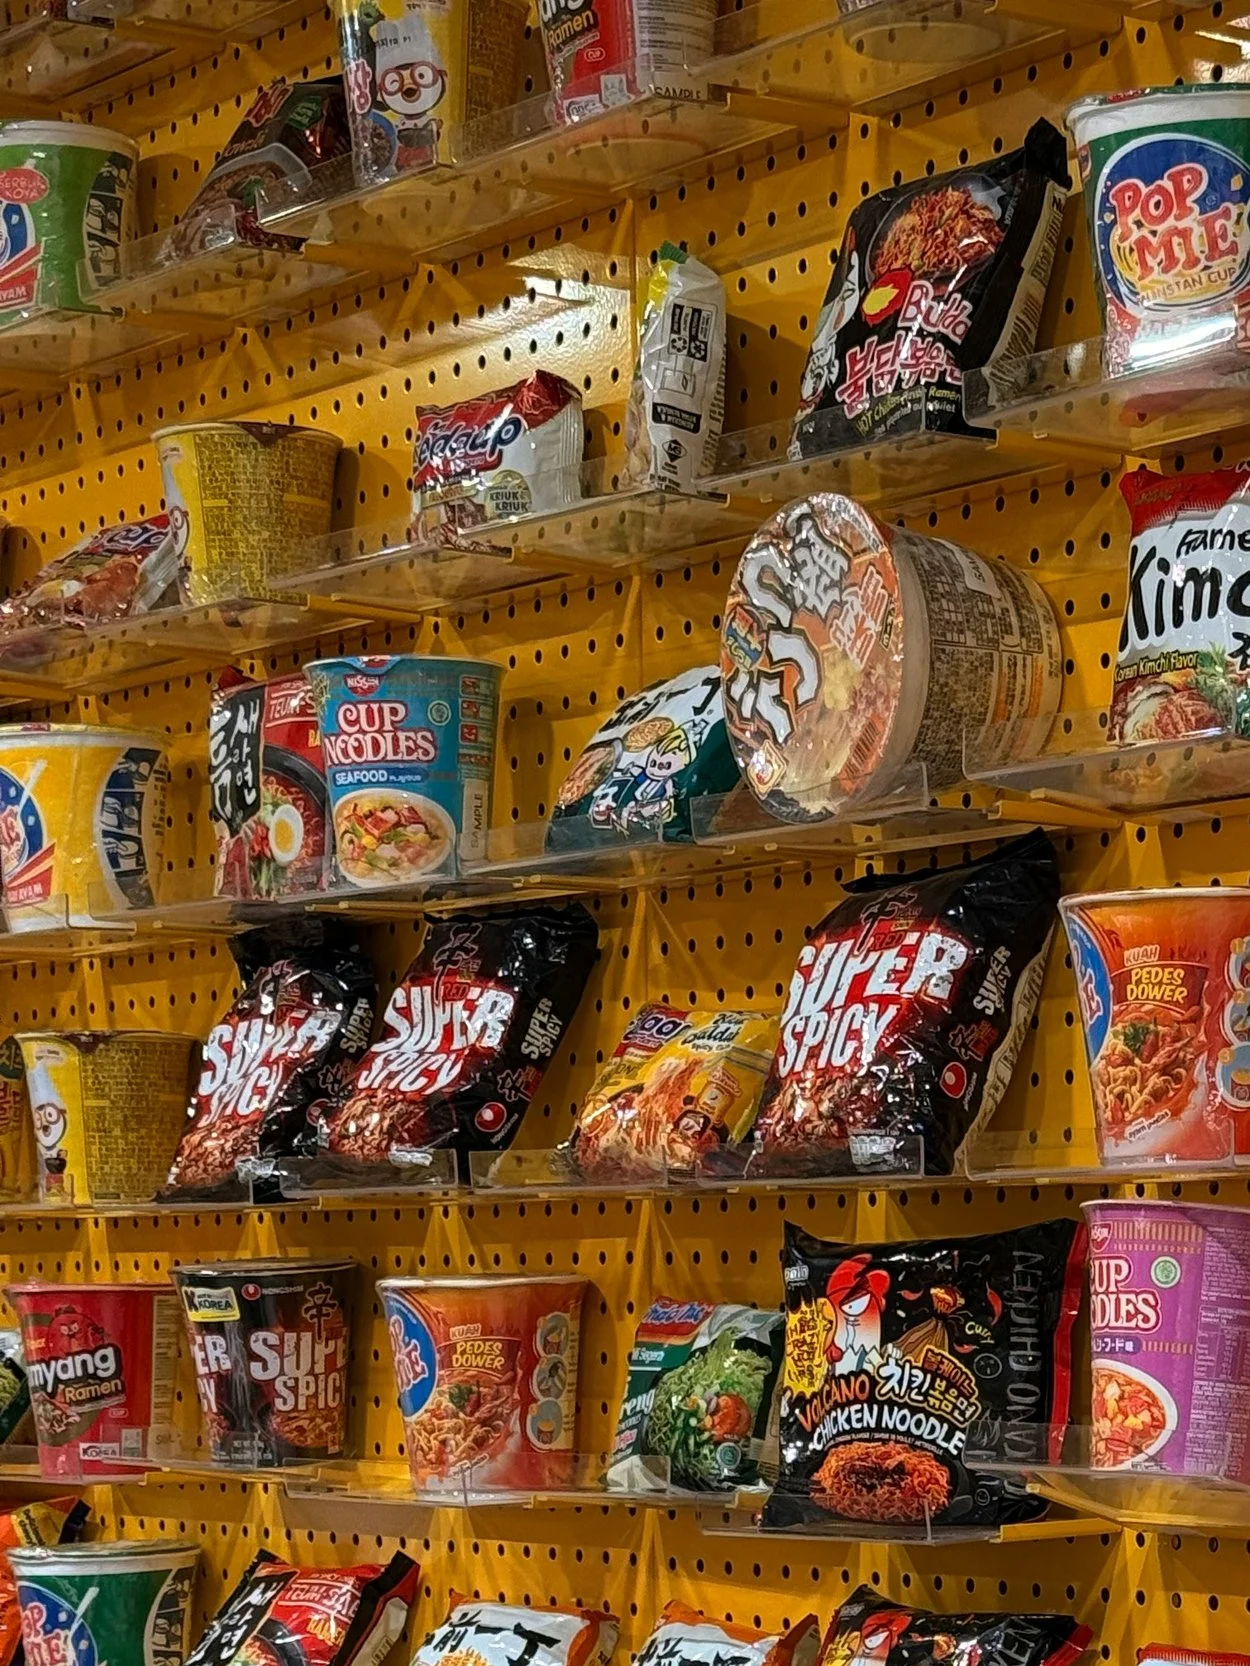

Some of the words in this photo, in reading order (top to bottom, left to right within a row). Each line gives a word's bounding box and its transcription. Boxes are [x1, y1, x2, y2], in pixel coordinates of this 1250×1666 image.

[548, 11, 595, 48] Ramen
[1110, 164, 1205, 244] POP
[1133, 205, 1239, 281] MIE
[1208, 267, 1237, 284] CUP
[495, 501, 529, 512] KRIUK
[1138, 654, 1170, 676] Kimchi
[1170, 651, 1198, 673] Flavor
[337, 702, 406, 732] CUP
[324, 731, 436, 766] NOODLES
[335, 770, 388, 785] SEAFOOD
[1125, 947, 1159, 965] KUAH
[781, 931, 970, 1028] SUPER
[973, 945, 1011, 1016] SUPER
[1127, 985, 1188, 1002] DOWER
[1131, 968, 1185, 985] PEDES
[371, 983, 515, 1053] SUPER
[521, 997, 552, 1060] SUPER
[539, 1014, 563, 1058] SPICY
[200, 1009, 343, 1096] SUPER
[778, 1002, 901, 1079] SPICY
[359, 1049, 464, 1096] SPICY
[200, 1062, 282, 1127] SPICY
[198, 1299, 233, 1311] KOREA
[1003, 1250, 1045, 1373] CHICKEN
[454, 1340, 503, 1356] PEDES
[965, 1321, 995, 1344] Curry
[451, 1352, 504, 1370] DOWER
[64, 1378, 123, 1402] Ramen
[880, 1362, 929, 1400] 치킨
[797, 1375, 870, 1433] VOLCANO
[812, 1402, 878, 1451] CHICKEN
[882, 1404, 966, 1455] NOODLE
